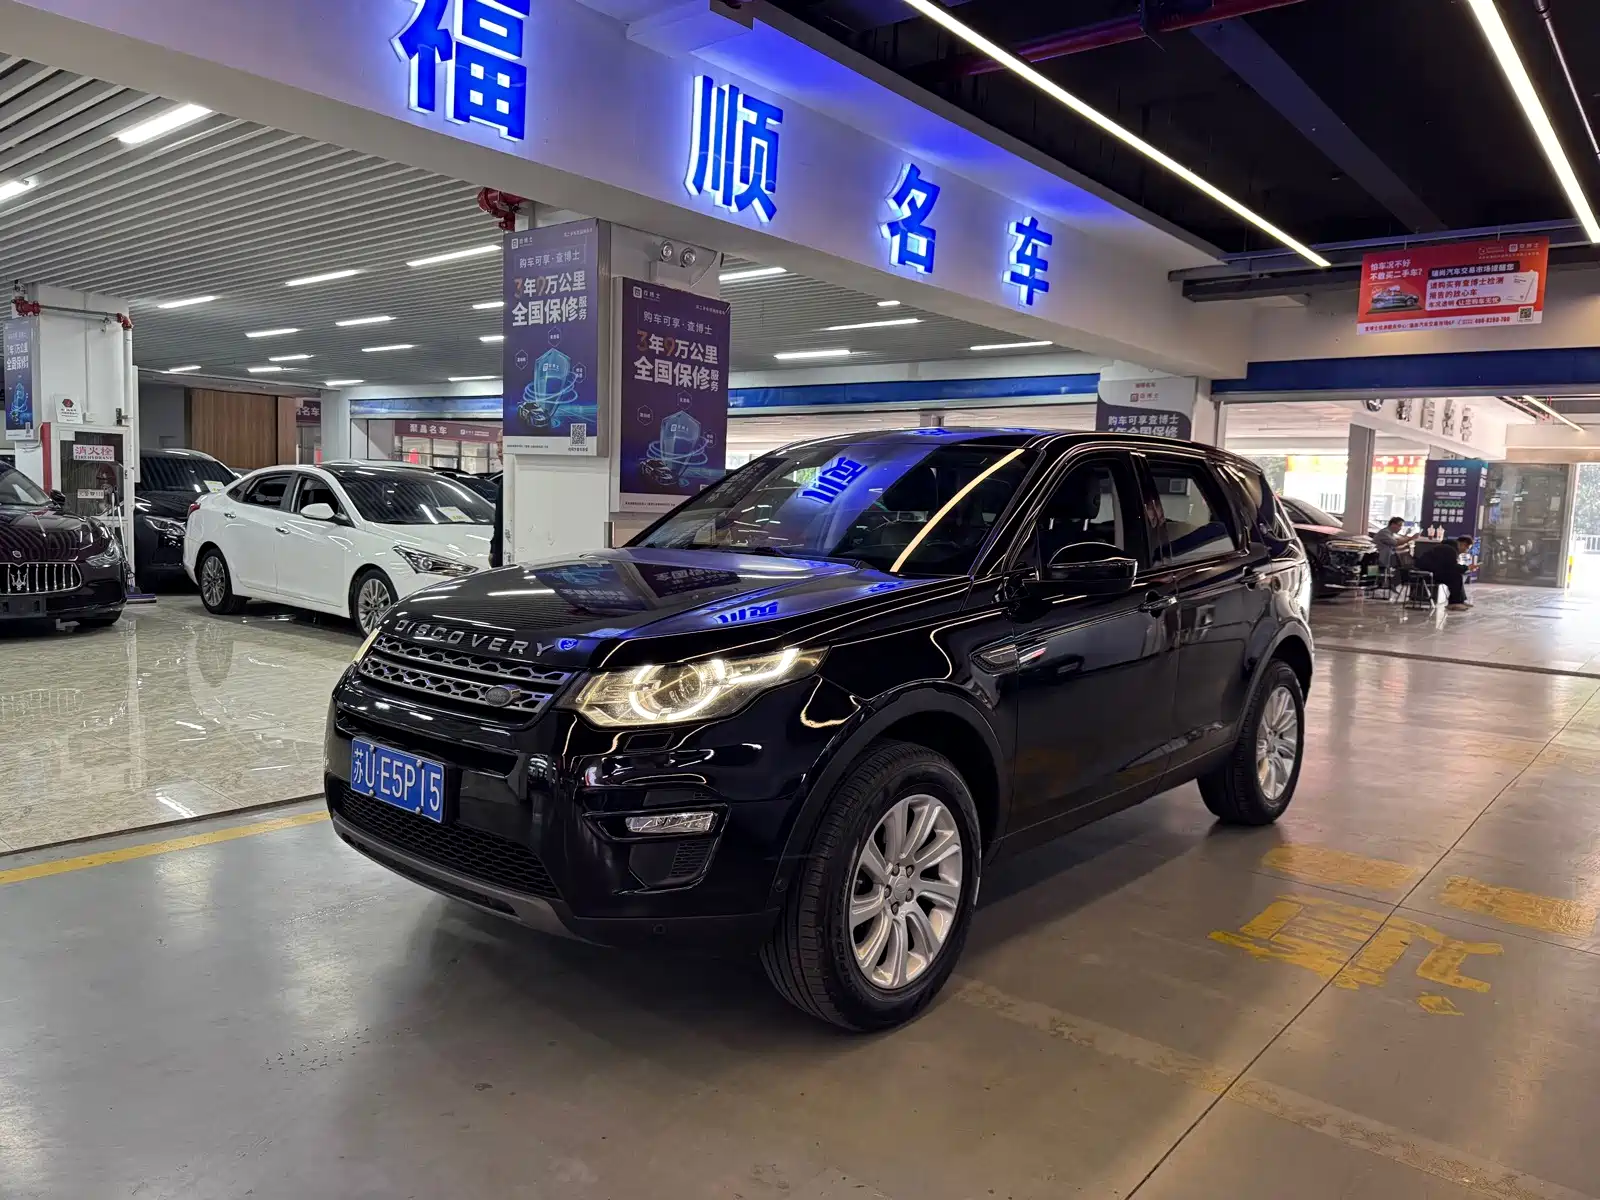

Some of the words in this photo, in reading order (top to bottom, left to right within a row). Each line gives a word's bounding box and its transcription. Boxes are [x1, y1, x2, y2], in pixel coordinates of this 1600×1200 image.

[513, 270, 587, 299] 3年9万公里
[511, 296, 578, 327] 全国保修
[636, 328, 719, 365] 3年9万公里
[633, 355, 711, 391] 全国保修
[75, 446, 113, 456] 消火栓
[395, 619, 555, 657] DISCOVERY
